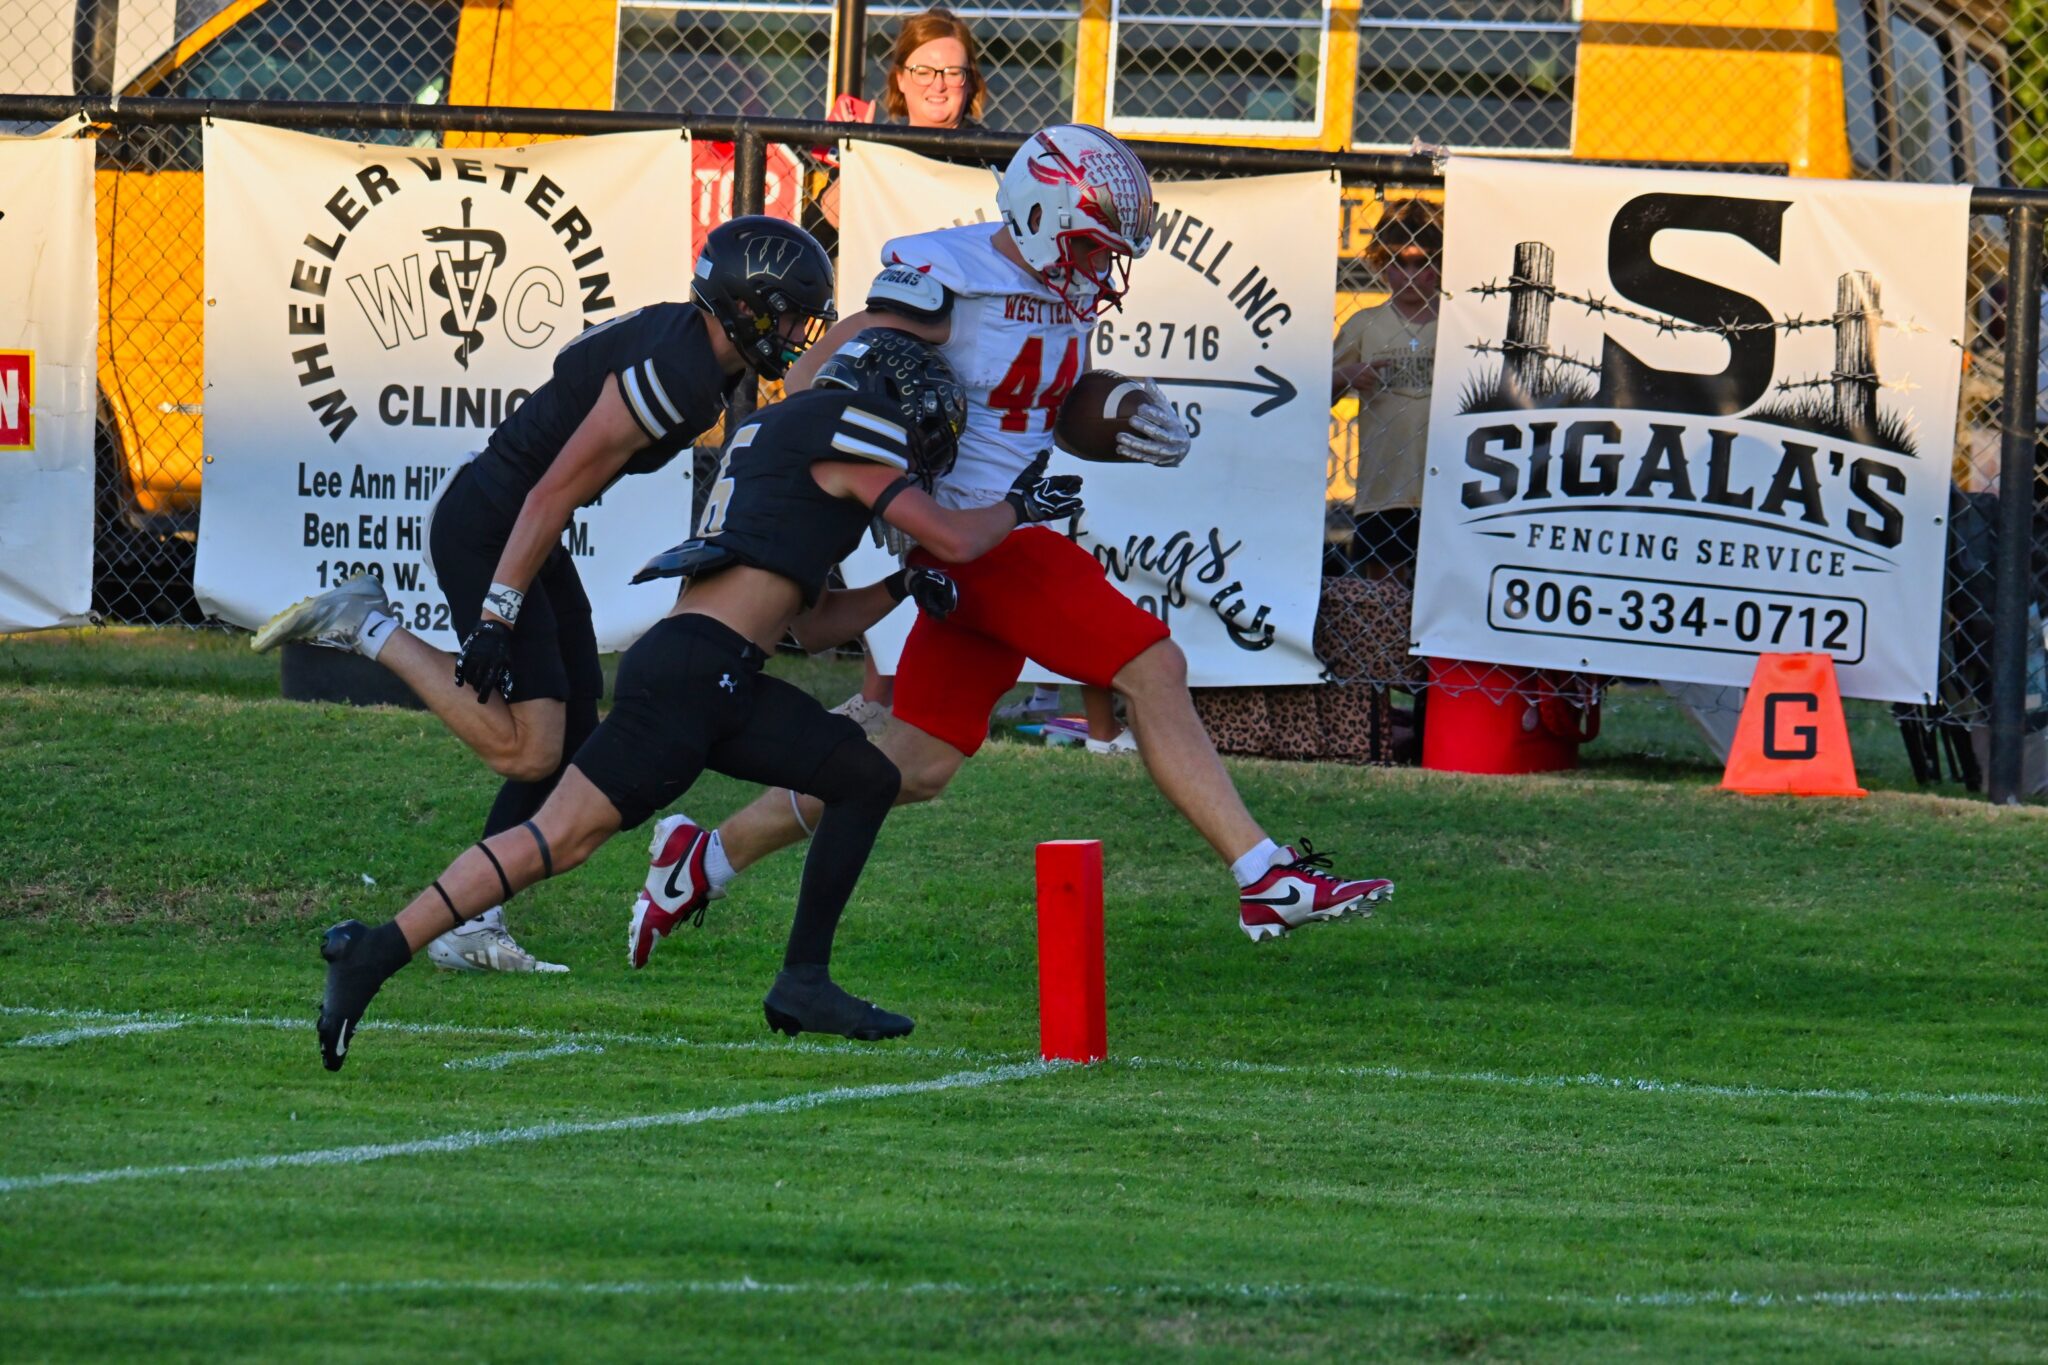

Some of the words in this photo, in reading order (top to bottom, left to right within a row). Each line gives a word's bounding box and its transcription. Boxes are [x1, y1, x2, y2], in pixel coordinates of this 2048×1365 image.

[288, 164, 401, 443] WHEELER
[409, 156, 616, 331] VETERIN
[1004, 294, 1043, 324] WEST
[1227, 265, 1292, 350] INC.
[1603, 192, 1795, 417] S
[988, 336, 1079, 433] 44
[298, 462, 342, 498] Lee
[350, 464, 396, 500] Ann
[1461, 420, 1906, 550] SIGALA'S
[304, 512, 350, 549] Ben
[358, 514, 388, 550] Ed
[1527, 523, 1679, 562] FENCING
[1696, 539, 1846, 577] SERVICE
[393, 562, 426, 592] W.
[1503, 578, 1850, 652] 806-334-0712
[1763, 693, 1819, 760] G
